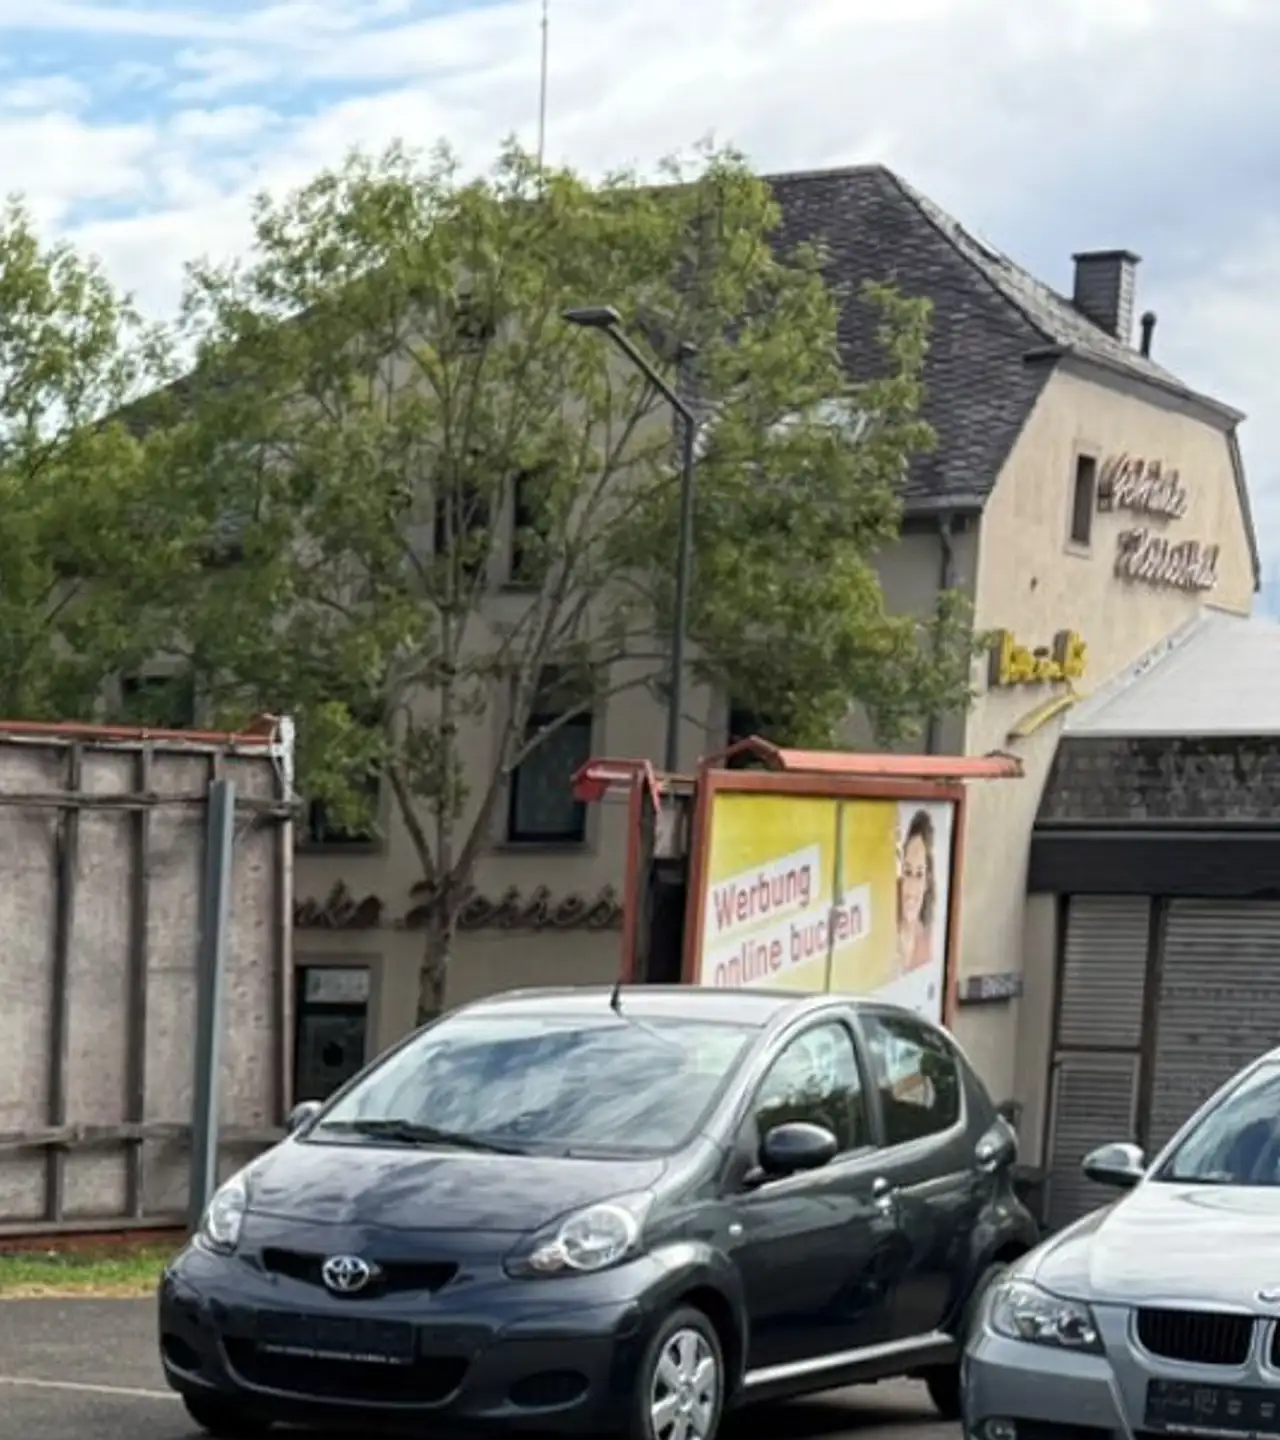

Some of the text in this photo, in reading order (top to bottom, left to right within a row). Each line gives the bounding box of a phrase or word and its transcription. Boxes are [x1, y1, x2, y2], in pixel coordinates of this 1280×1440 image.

[713, 863, 811, 932] Werbung
[714, 903, 862, 987] online bucen
